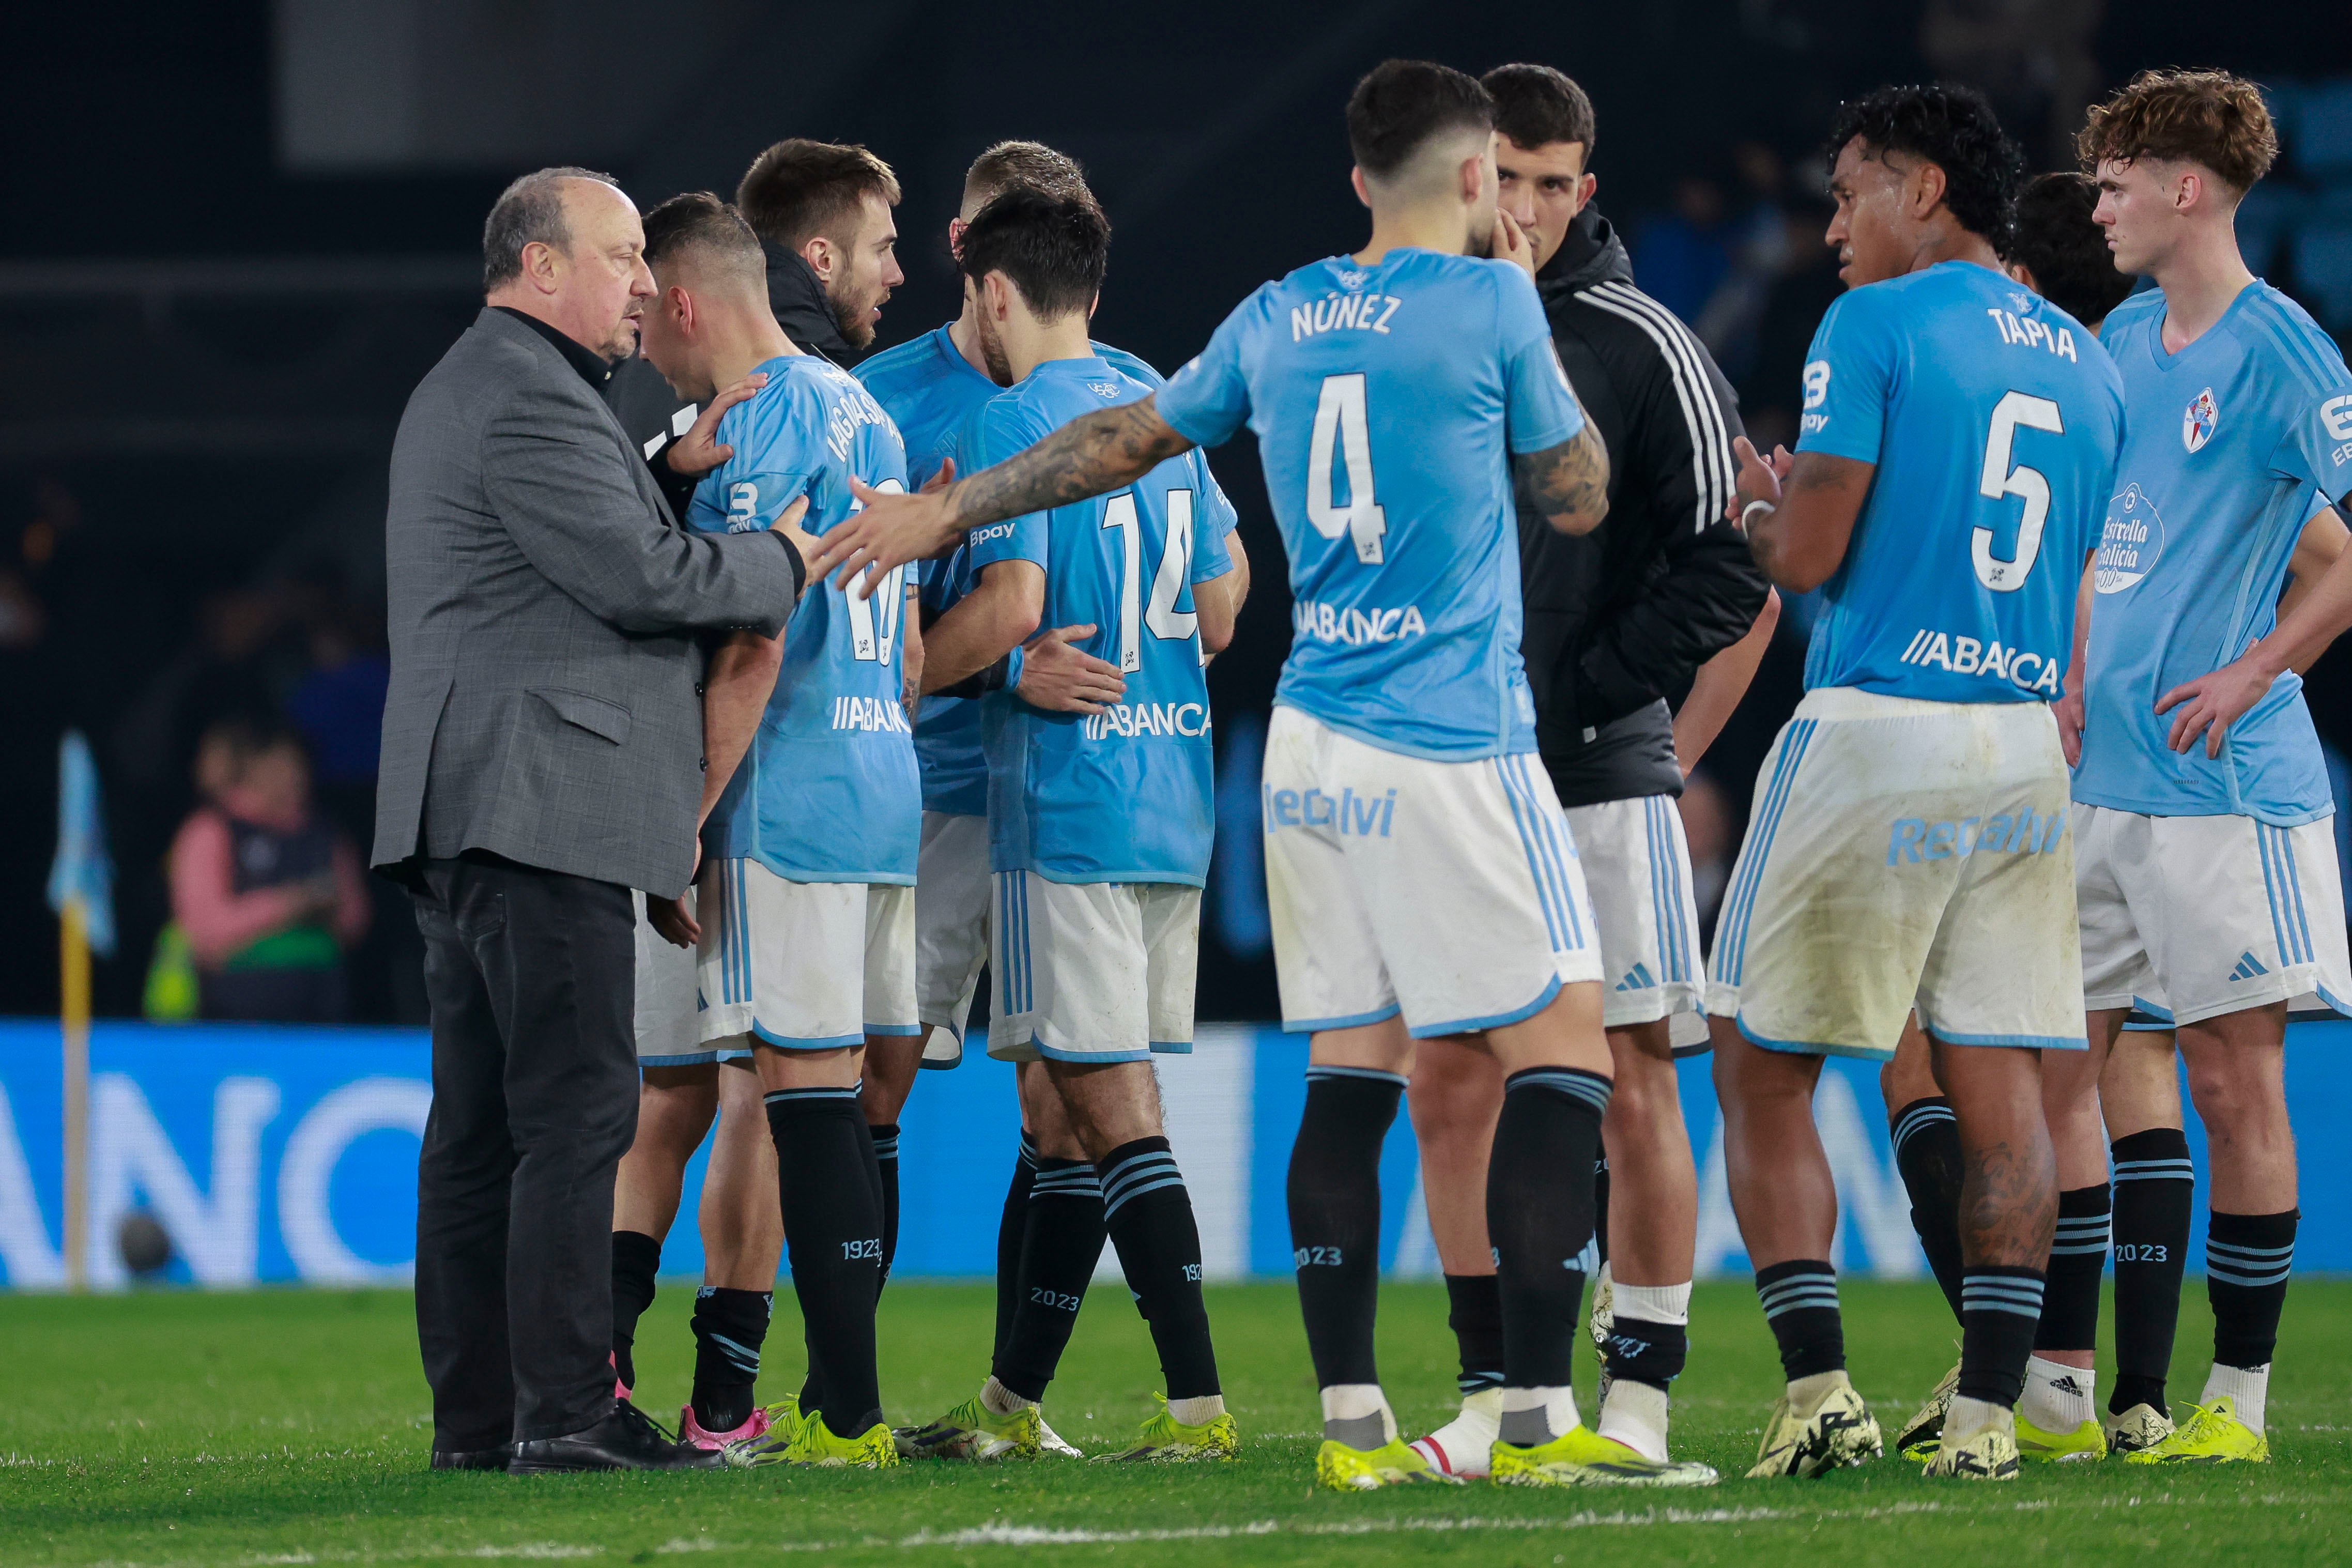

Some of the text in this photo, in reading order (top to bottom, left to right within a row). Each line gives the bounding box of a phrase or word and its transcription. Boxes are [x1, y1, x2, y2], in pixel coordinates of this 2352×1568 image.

[1291, 291, 1402, 343] NÚÑEZ
[1987, 308, 2078, 364] TAPIA
[1305, 373, 1388, 565] 4
[1970, 389, 2066, 593] 5
[1101, 488, 1206, 674] 14
[1886, 805, 2067, 866] Recalvi
[2116, 1244, 2166, 1262] 2023
[1031, 1287, 1080, 1312] 2023
[2050, 1380, 2083, 1397] adidas
